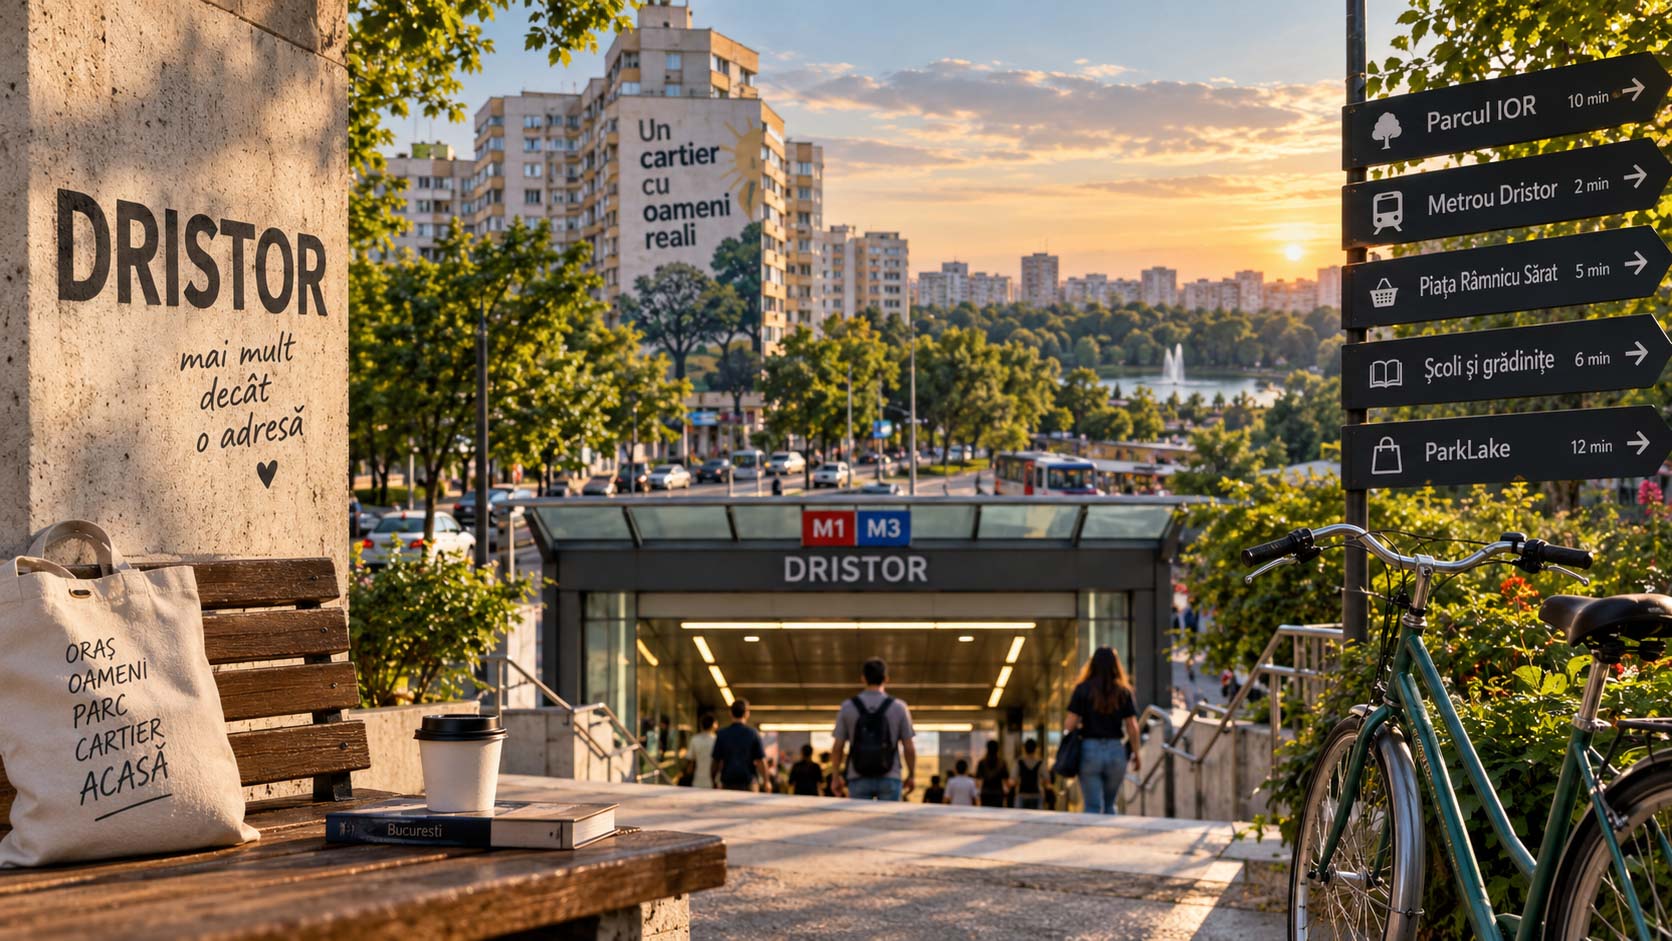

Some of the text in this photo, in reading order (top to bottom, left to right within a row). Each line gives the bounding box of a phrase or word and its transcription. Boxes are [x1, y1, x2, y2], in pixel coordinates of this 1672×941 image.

[1427, 91, 1610, 133] Parcul IOR 10 min
[638, 118, 671, 142] Un
[640, 141, 720, 169] cartier
[642, 177, 670, 196] cu
[1427, 177, 1610, 216] Metrou Dristor 2 min
[643, 192, 731, 223] oameni
[645, 222, 697, 250] reali
[56, 187, 329, 317] DRISTOR
[1460, 267, 1521, 293] Râmnicu
[1523, 263, 1559, 285] Sărat
[1575, 263, 1585, 279] 5
[1587, 262, 1611, 278] min
[180, 330, 297, 372] mai mult
[1574, 351, 1584, 367] 6
[1587, 351, 1612, 367] min
[199, 372, 273, 411] decât
[196, 404, 305, 453] o adresă
[1424, 437, 1614, 463] ParkLake 12 min
[812, 518, 845, 538] M1
[867, 518, 901, 538] M3
[784, 555, 928, 583] DRISTOR
[73, 693, 128, 729] PARC
[75, 718, 165, 762] CARTIER
[79, 742, 169, 806] ACASĂ
[387, 823, 443, 838] Bucuresti
